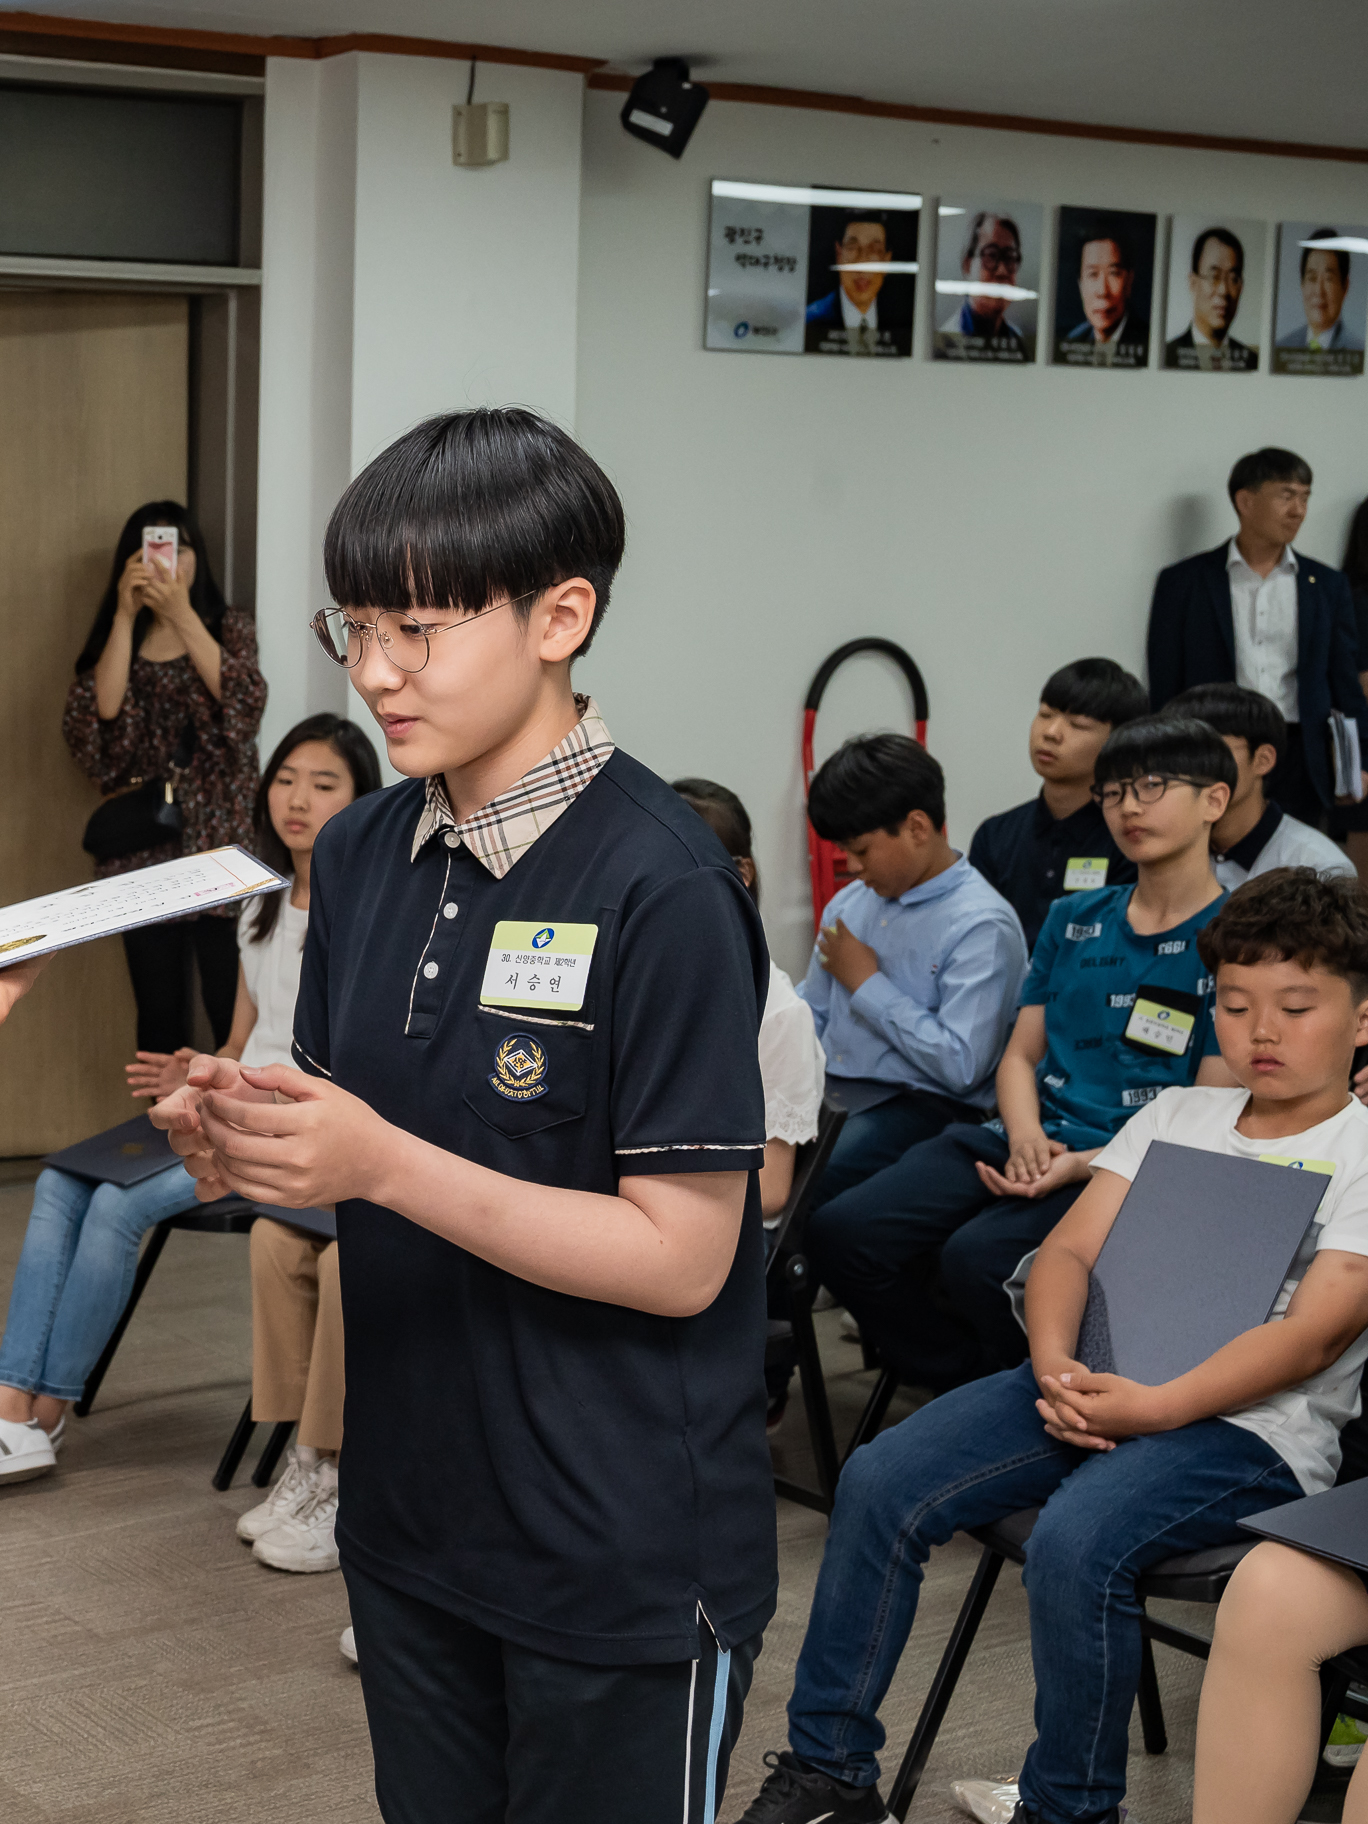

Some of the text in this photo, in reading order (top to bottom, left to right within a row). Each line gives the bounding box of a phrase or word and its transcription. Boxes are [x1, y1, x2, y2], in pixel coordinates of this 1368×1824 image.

[501, 953, 577, 968] 30. 신양중학교 제2학년
